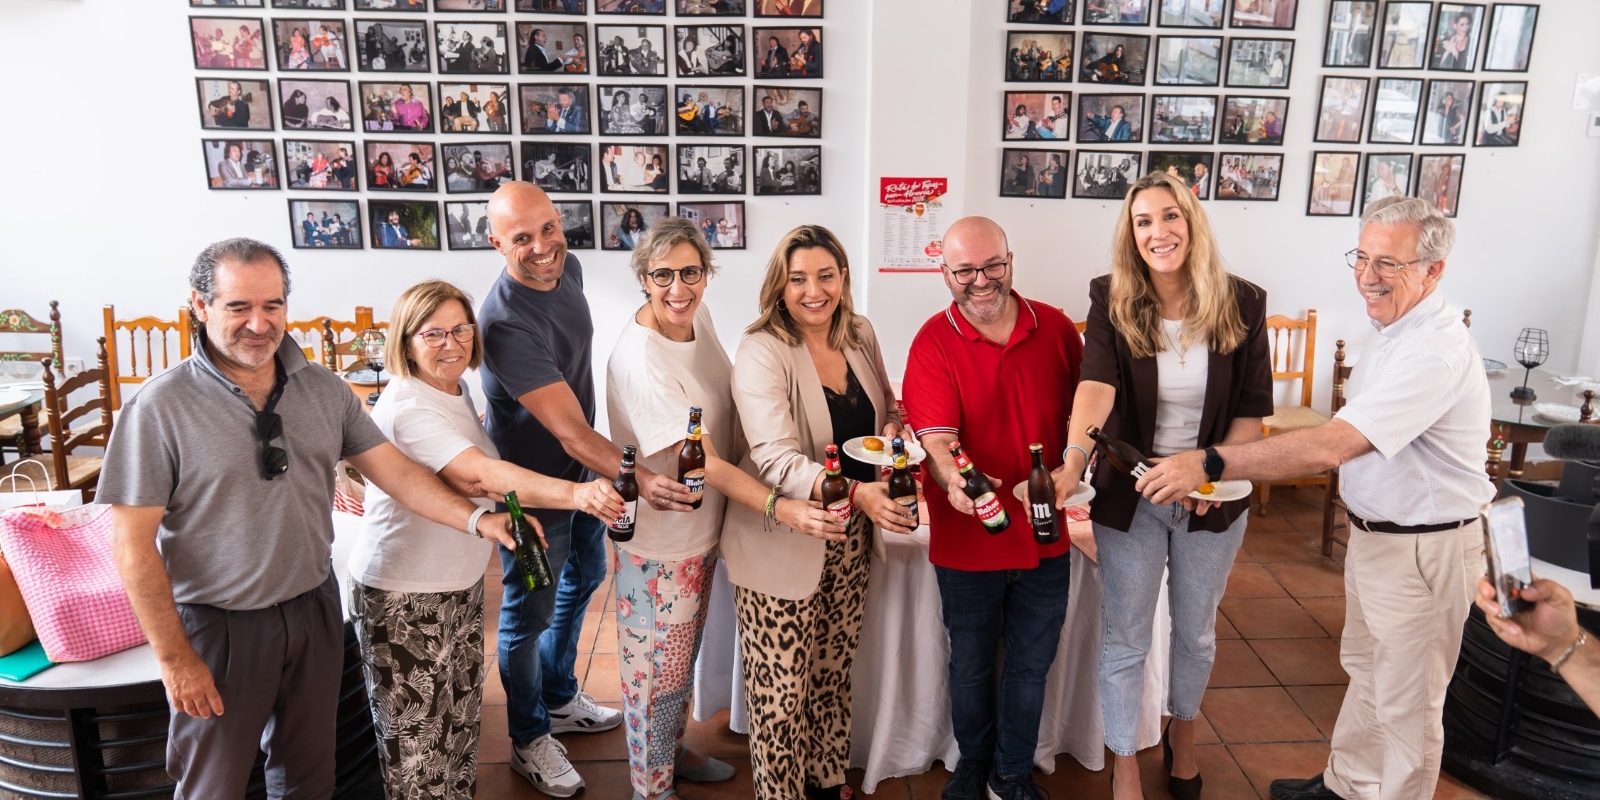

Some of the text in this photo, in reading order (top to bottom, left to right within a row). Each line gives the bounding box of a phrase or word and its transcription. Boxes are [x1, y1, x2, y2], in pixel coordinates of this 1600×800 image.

[885, 182, 910, 192] Ruta
[922, 180, 943, 190] Tapas
[976, 500, 999, 515] Mahou
